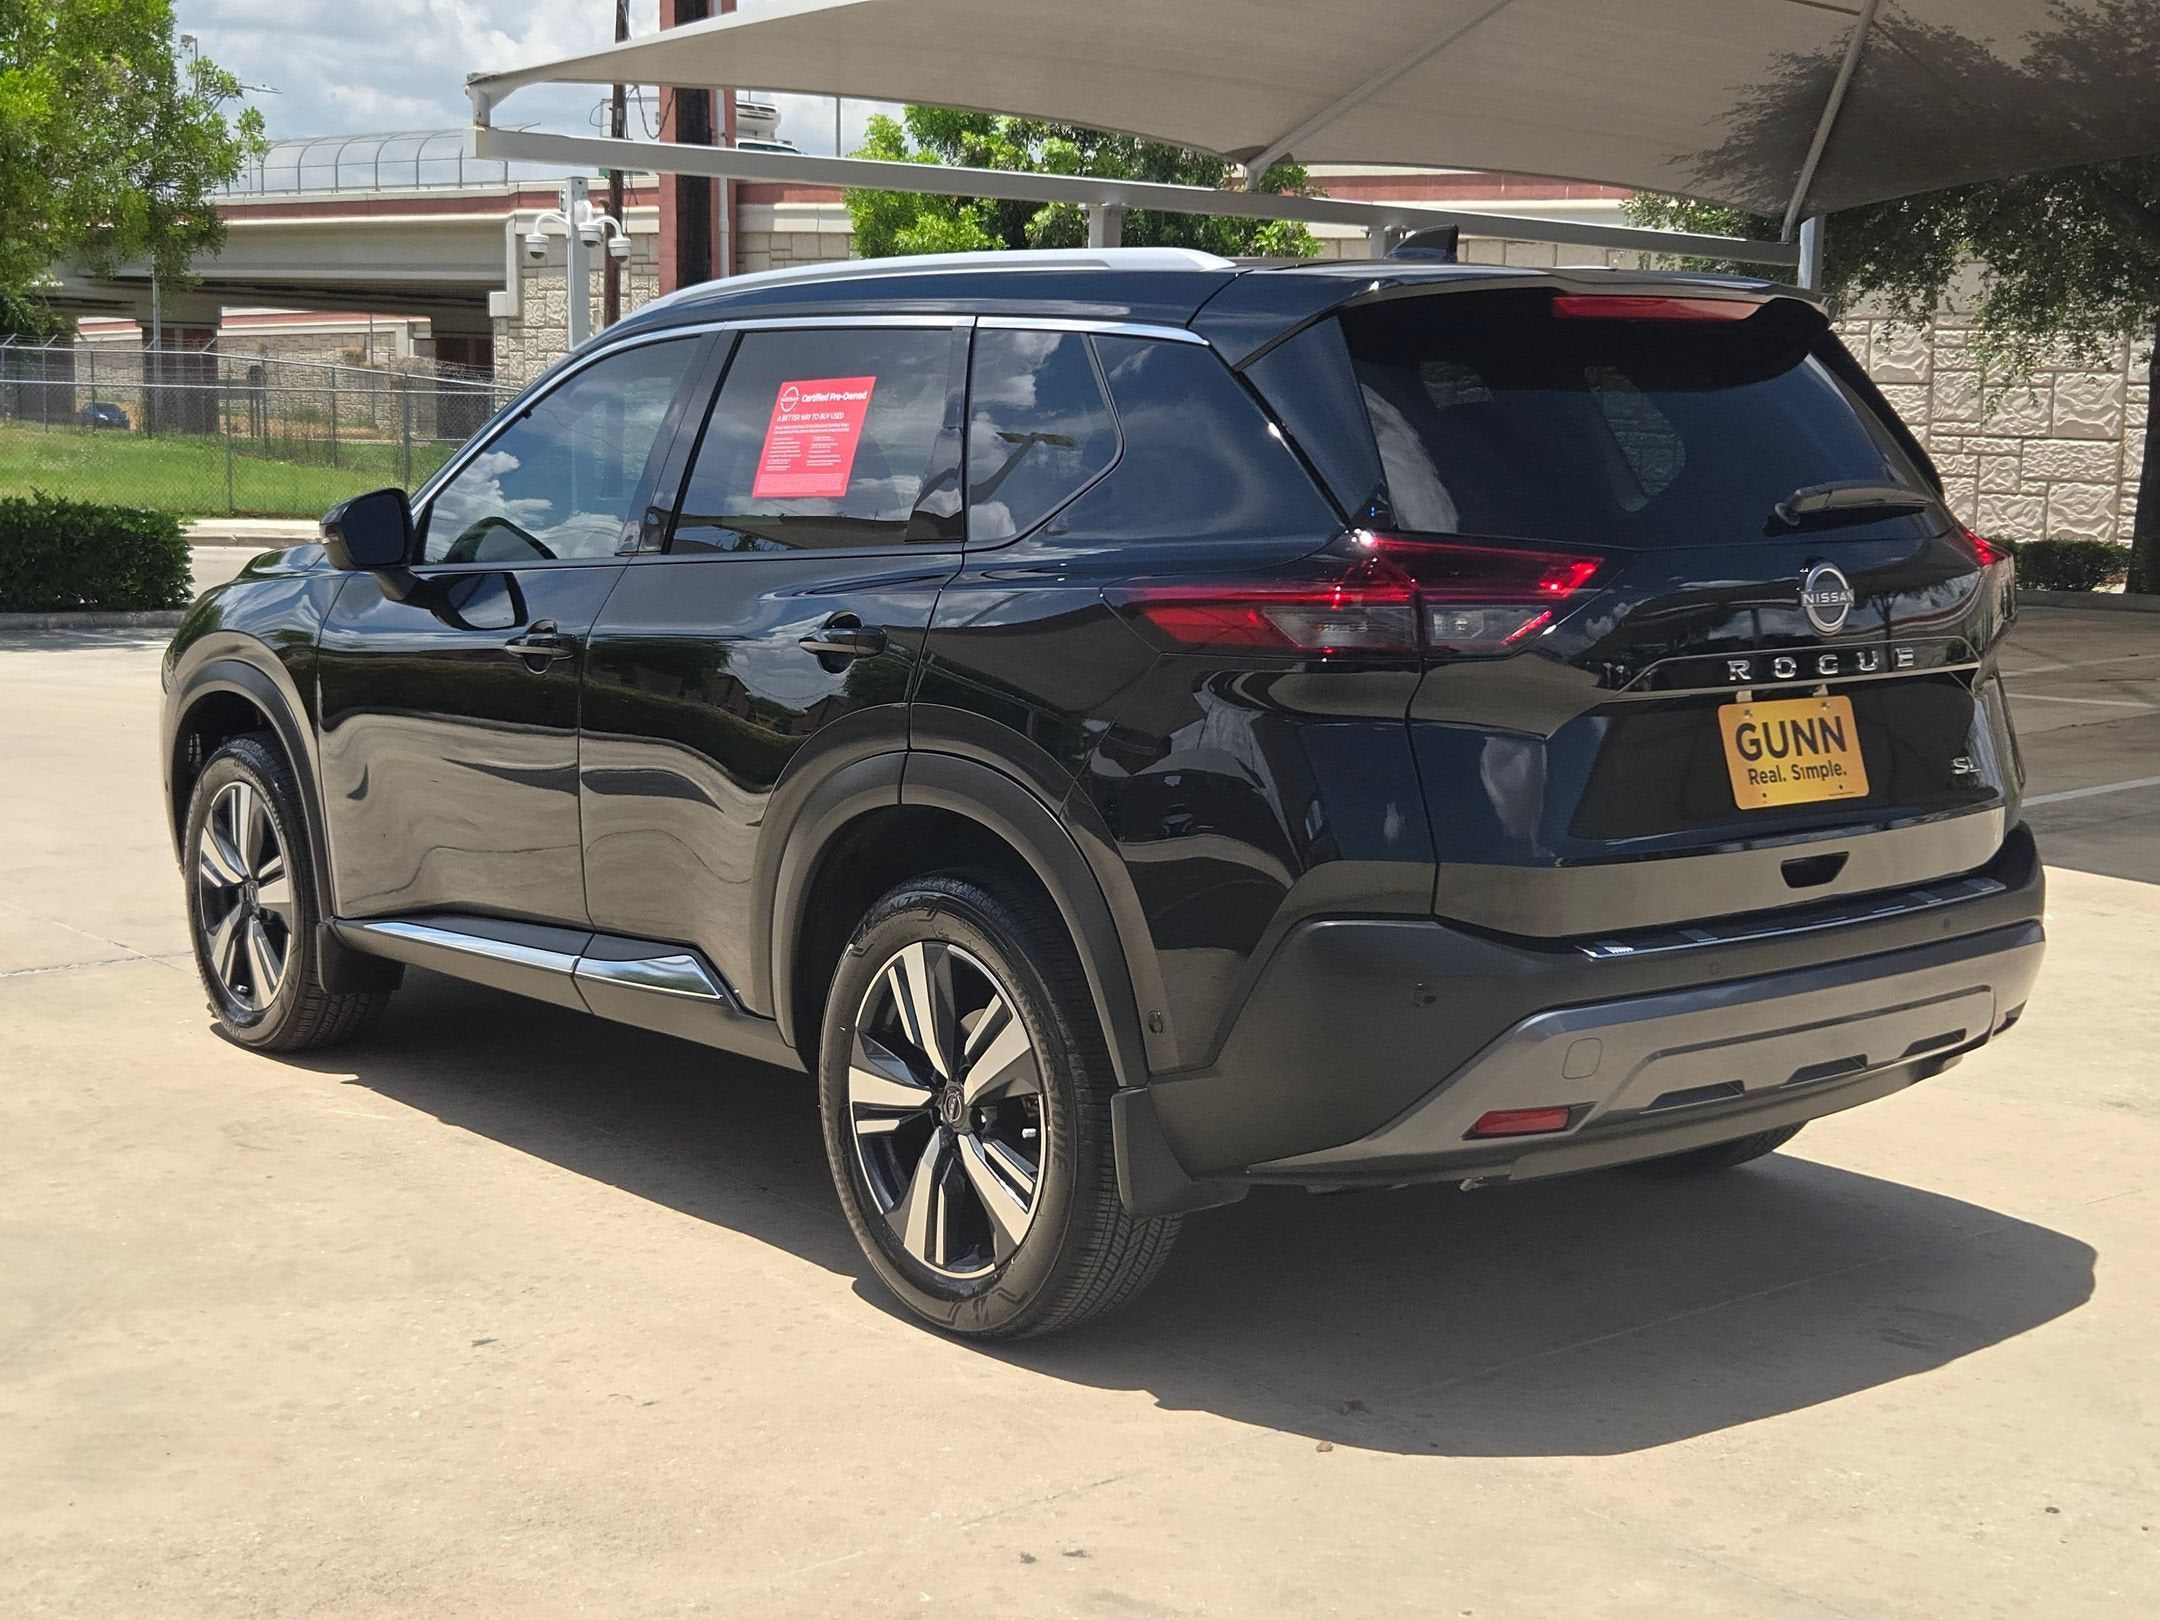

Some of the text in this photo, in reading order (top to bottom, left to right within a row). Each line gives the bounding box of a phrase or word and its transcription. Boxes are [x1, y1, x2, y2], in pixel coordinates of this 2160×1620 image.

[801, 390, 868, 403] Certified Pre-Owned
[830, 411, 845, 420] USED
[1802, 590, 1854, 604] NISSAN
[1727, 647, 1914, 681] ROGUE
[1735, 716, 1848, 762] GUNN
[1747, 760, 1847, 786] Real. Simple.
